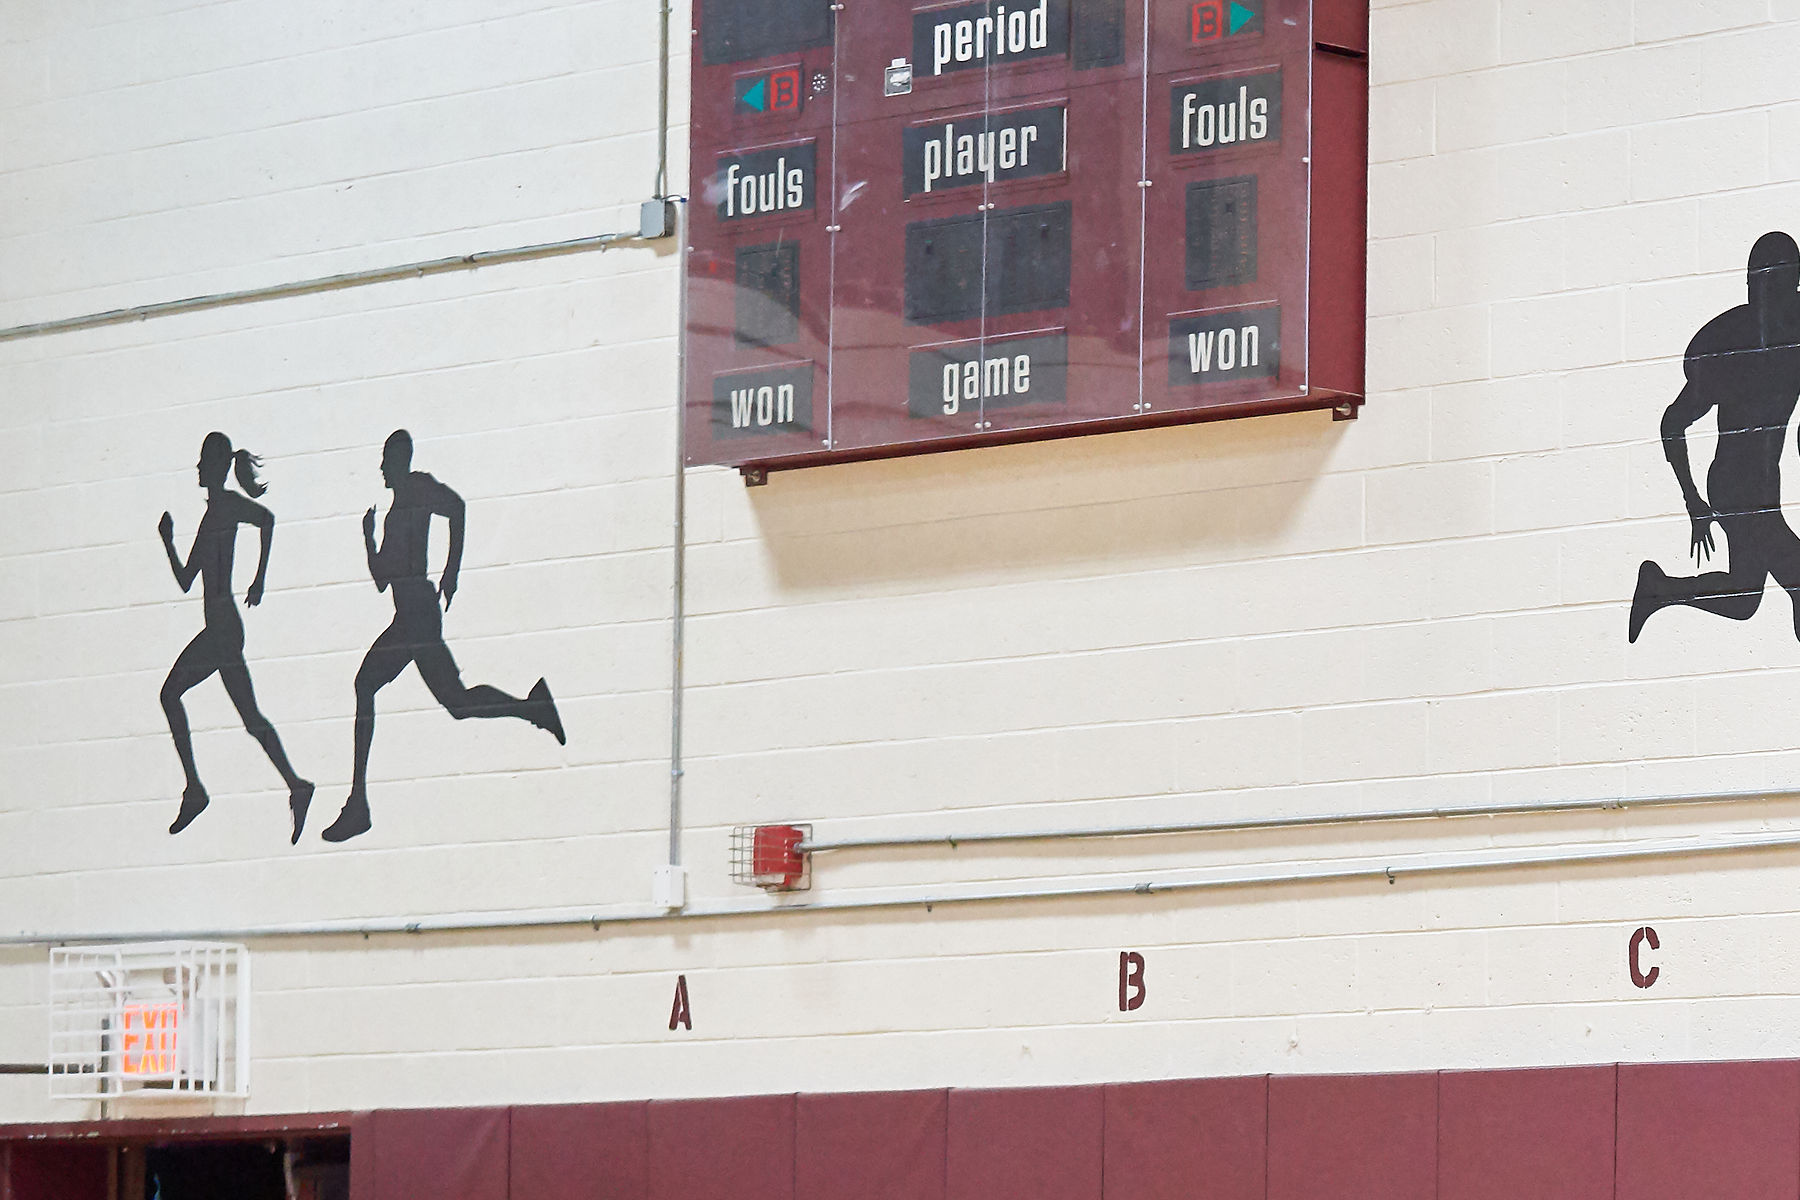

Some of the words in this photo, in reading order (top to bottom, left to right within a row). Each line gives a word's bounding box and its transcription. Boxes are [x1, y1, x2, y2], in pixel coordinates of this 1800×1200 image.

[933, 0, 1048, 76] period
[1182, 85, 1268, 149] fouls
[727, 157, 803, 217] fouls
[924, 123, 1038, 193] player
[1188, 325, 1259, 374] won
[730, 383, 794, 429] won
[943, 354, 1030, 415] game
[1118, 951, 1146, 1012] B
[1628, 926, 1661, 990] C
[668, 974, 693, 1031] A
